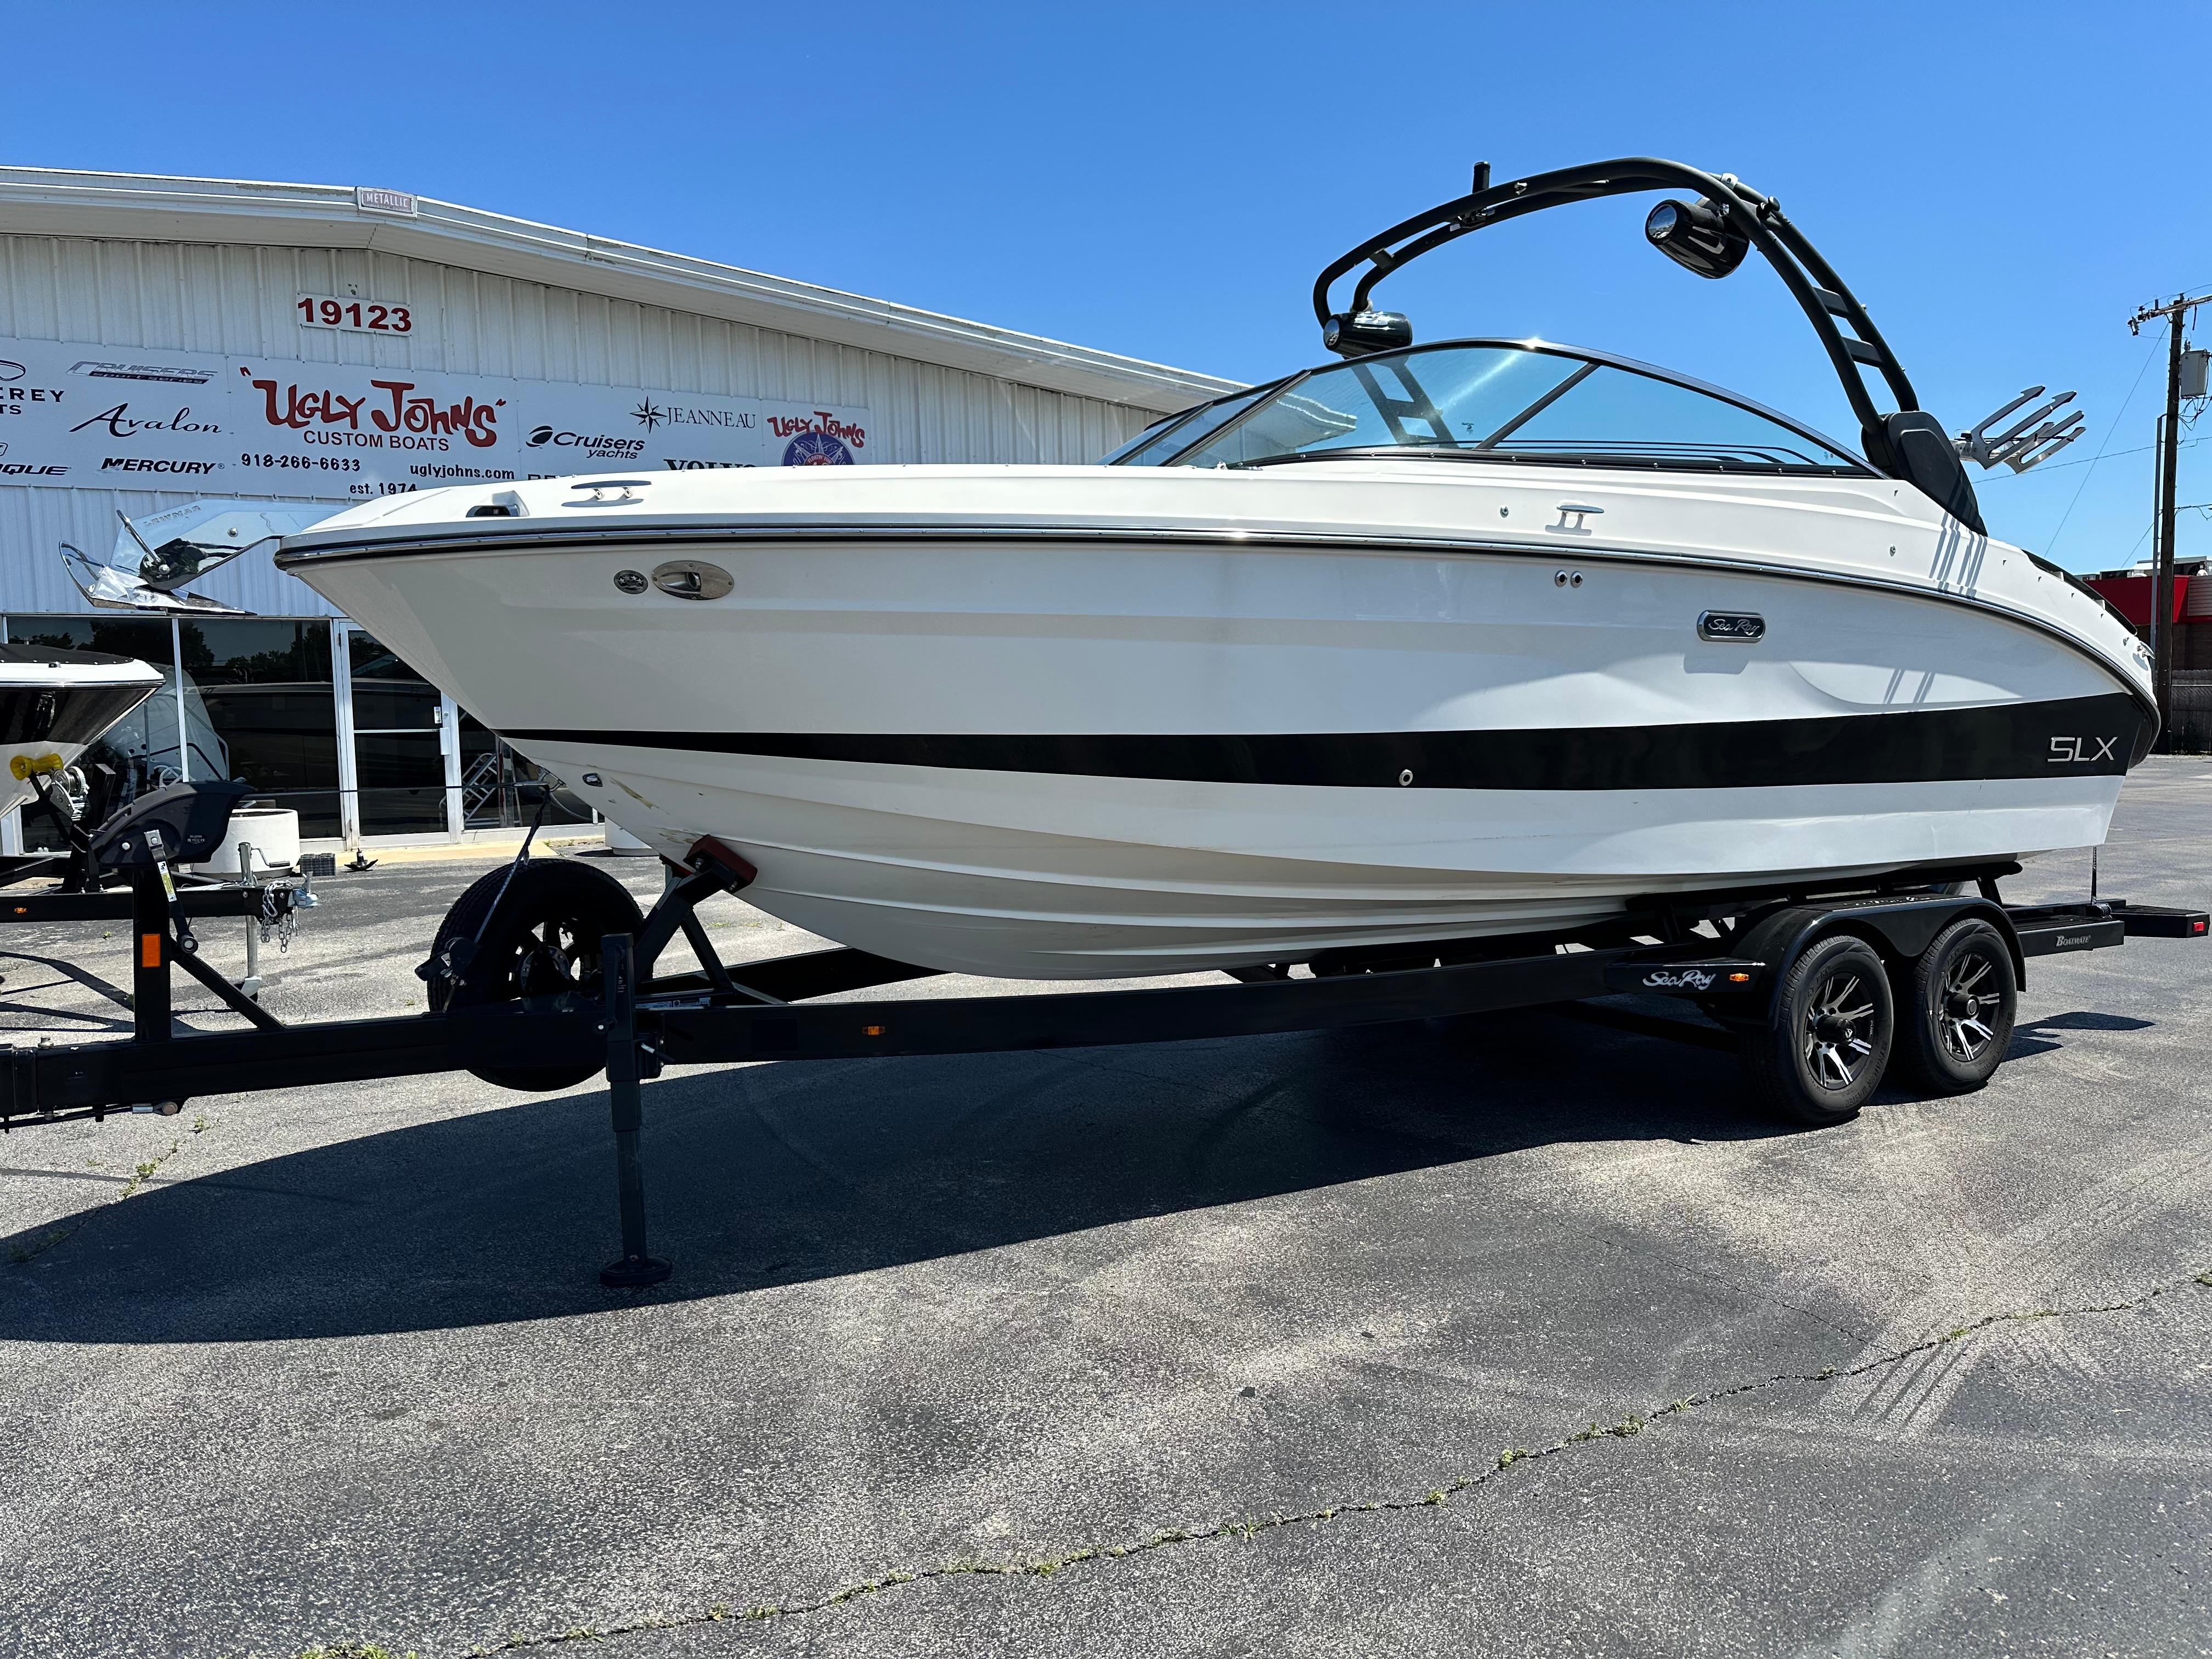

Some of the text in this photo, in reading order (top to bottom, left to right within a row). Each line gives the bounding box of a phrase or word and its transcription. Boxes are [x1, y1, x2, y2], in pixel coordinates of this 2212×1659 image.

[366, 193, 408, 207] METALLIC
[298, 298, 411, 332] 19123
[0, 386, 65, 403] REY
[69, 403, 222, 437] Avalon
[667, 408, 756, 428] JEANNEAU
[303, 431, 449, 451] CUSTOM BOATS
[553, 432, 645, 450] Cruisers
[241, 453, 360, 472] 918-266-6633
[586, 449, 638, 459] yachts
[410, 463, 515, 480] uglyjohns.com
[349, 483, 373, 494] est.
[1708, 619, 1761, 636] Sea Ray
[2047, 737, 2118, 762] SLX
[2056, 935, 2090, 947] BOATMATE
[1643, 969, 1716, 990] Sea Ray
